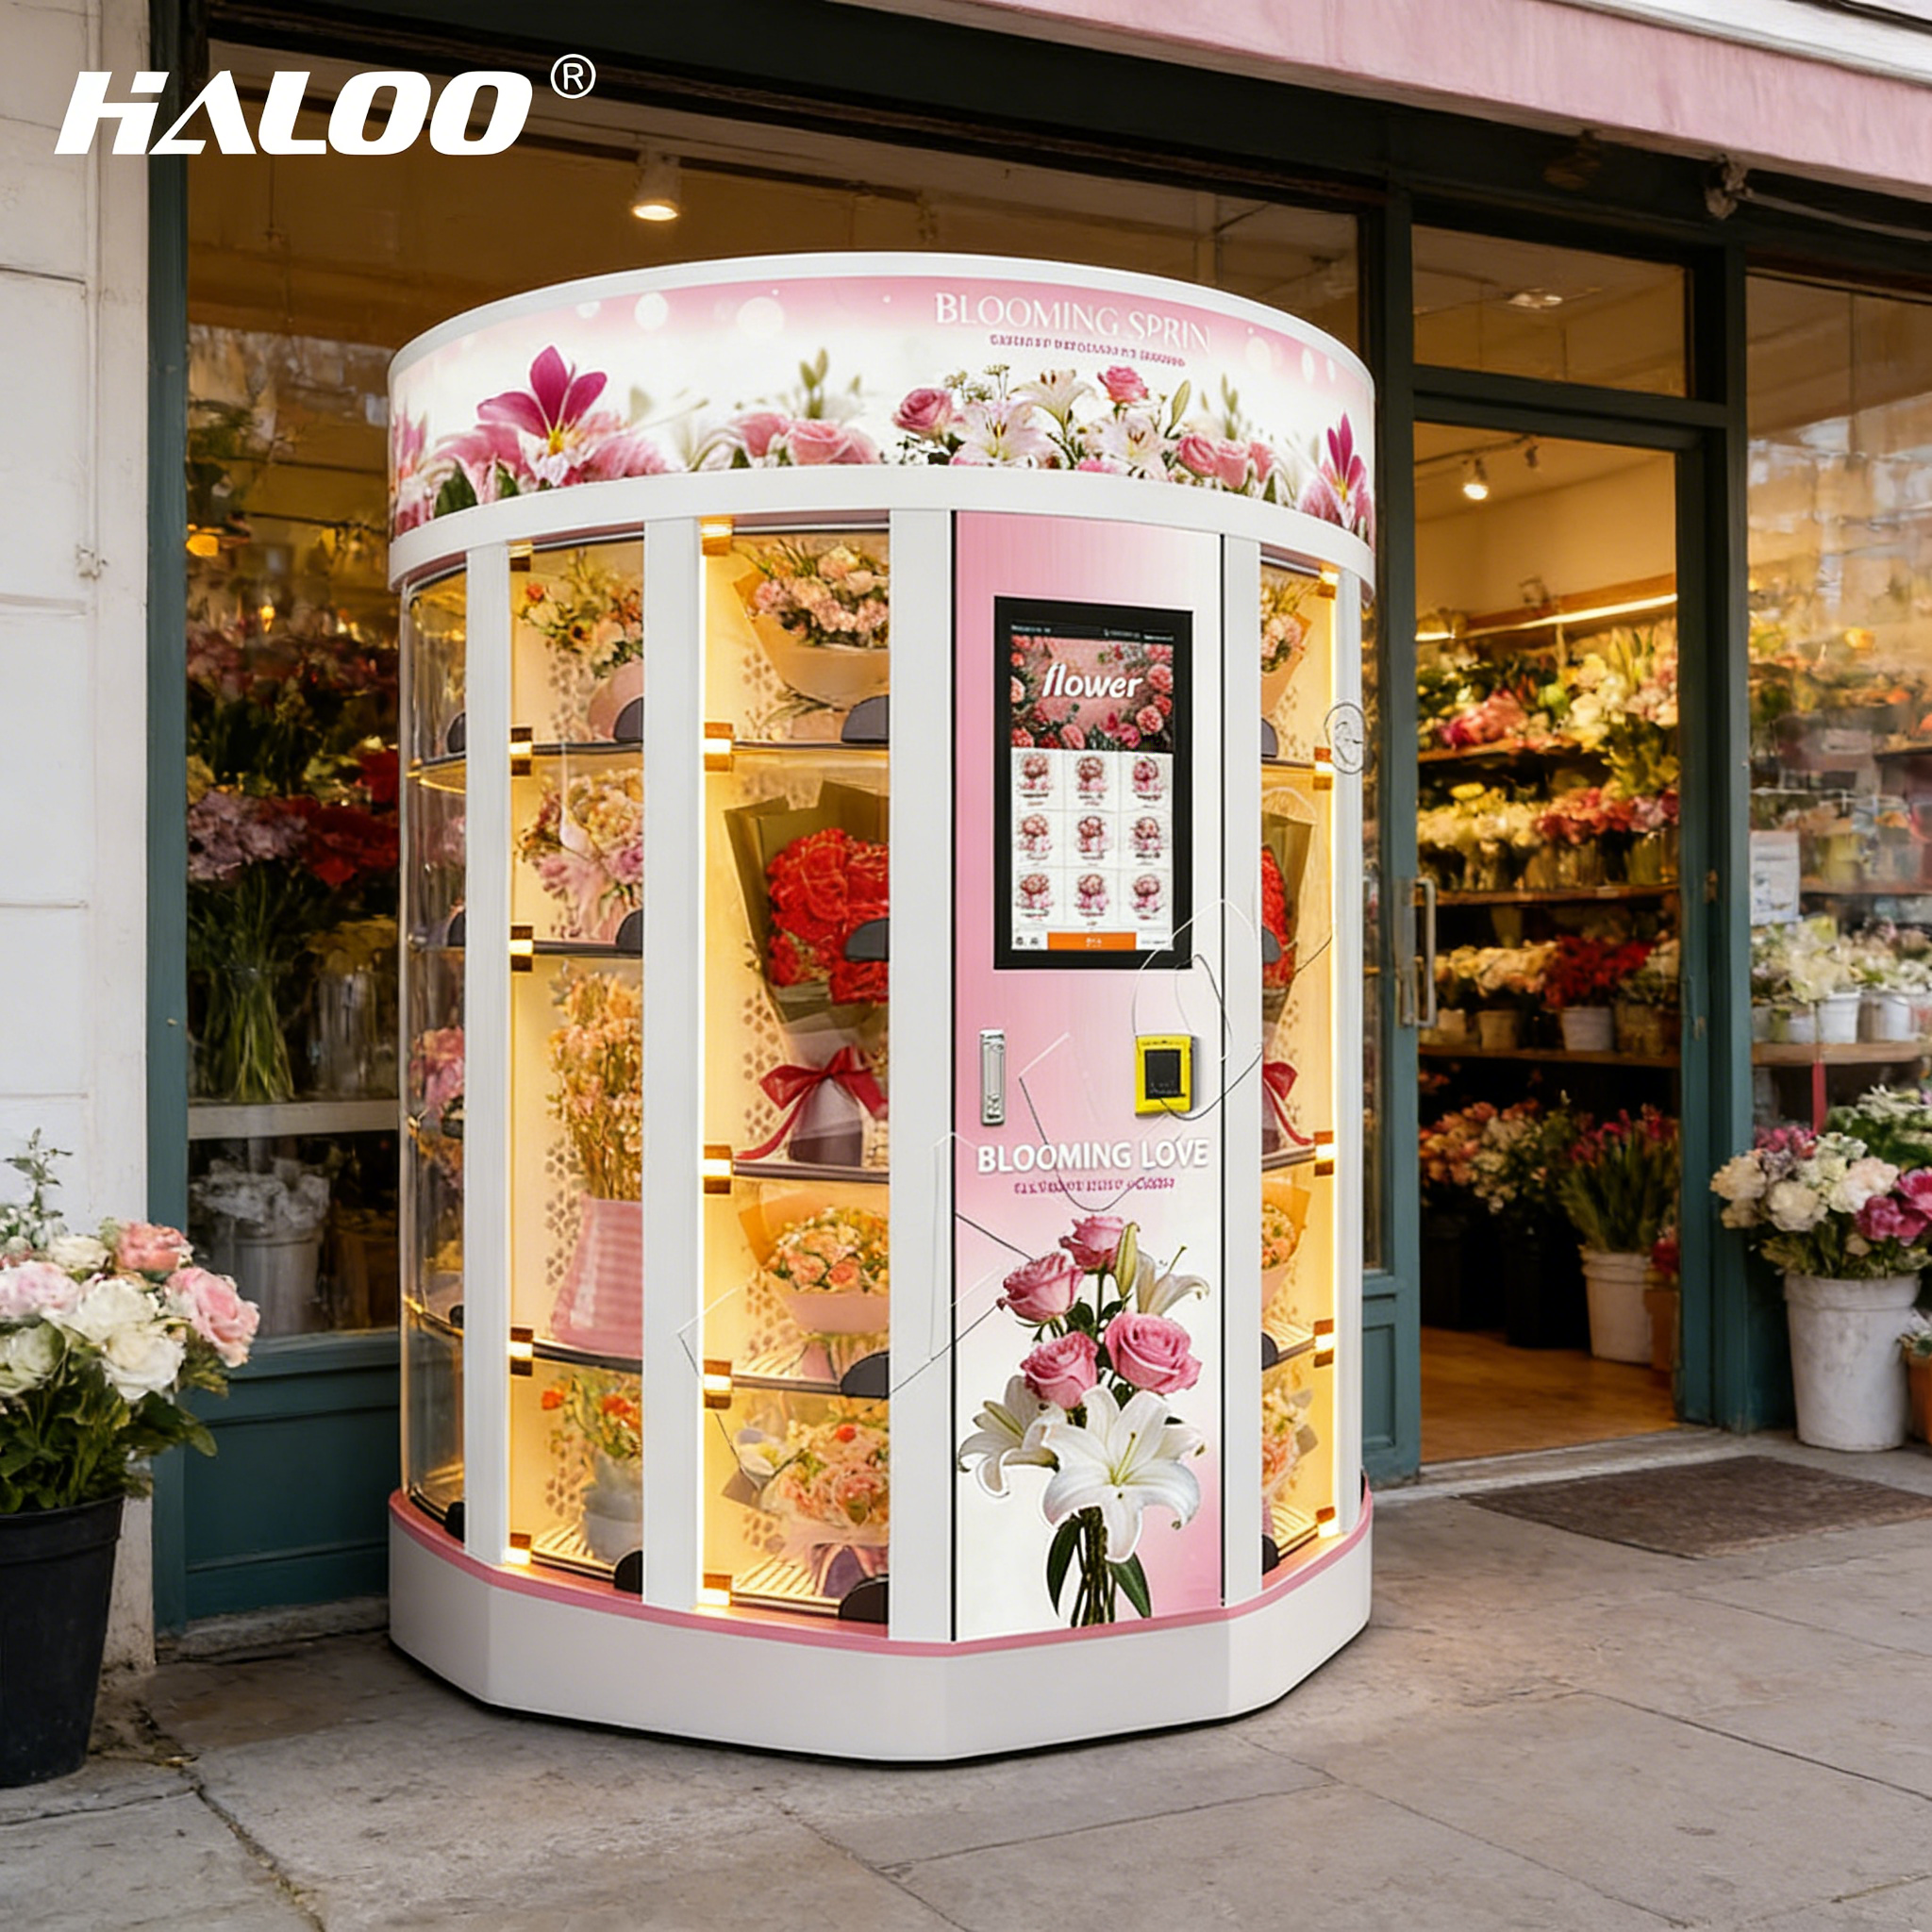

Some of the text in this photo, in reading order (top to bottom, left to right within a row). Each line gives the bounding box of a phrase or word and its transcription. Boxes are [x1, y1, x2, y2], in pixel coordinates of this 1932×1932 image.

[936, 293, 1118, 335] BLOOMING
[1041, 662, 1143, 698] flower
[977, 1139, 1209, 1173] BLOOMING LOVE
